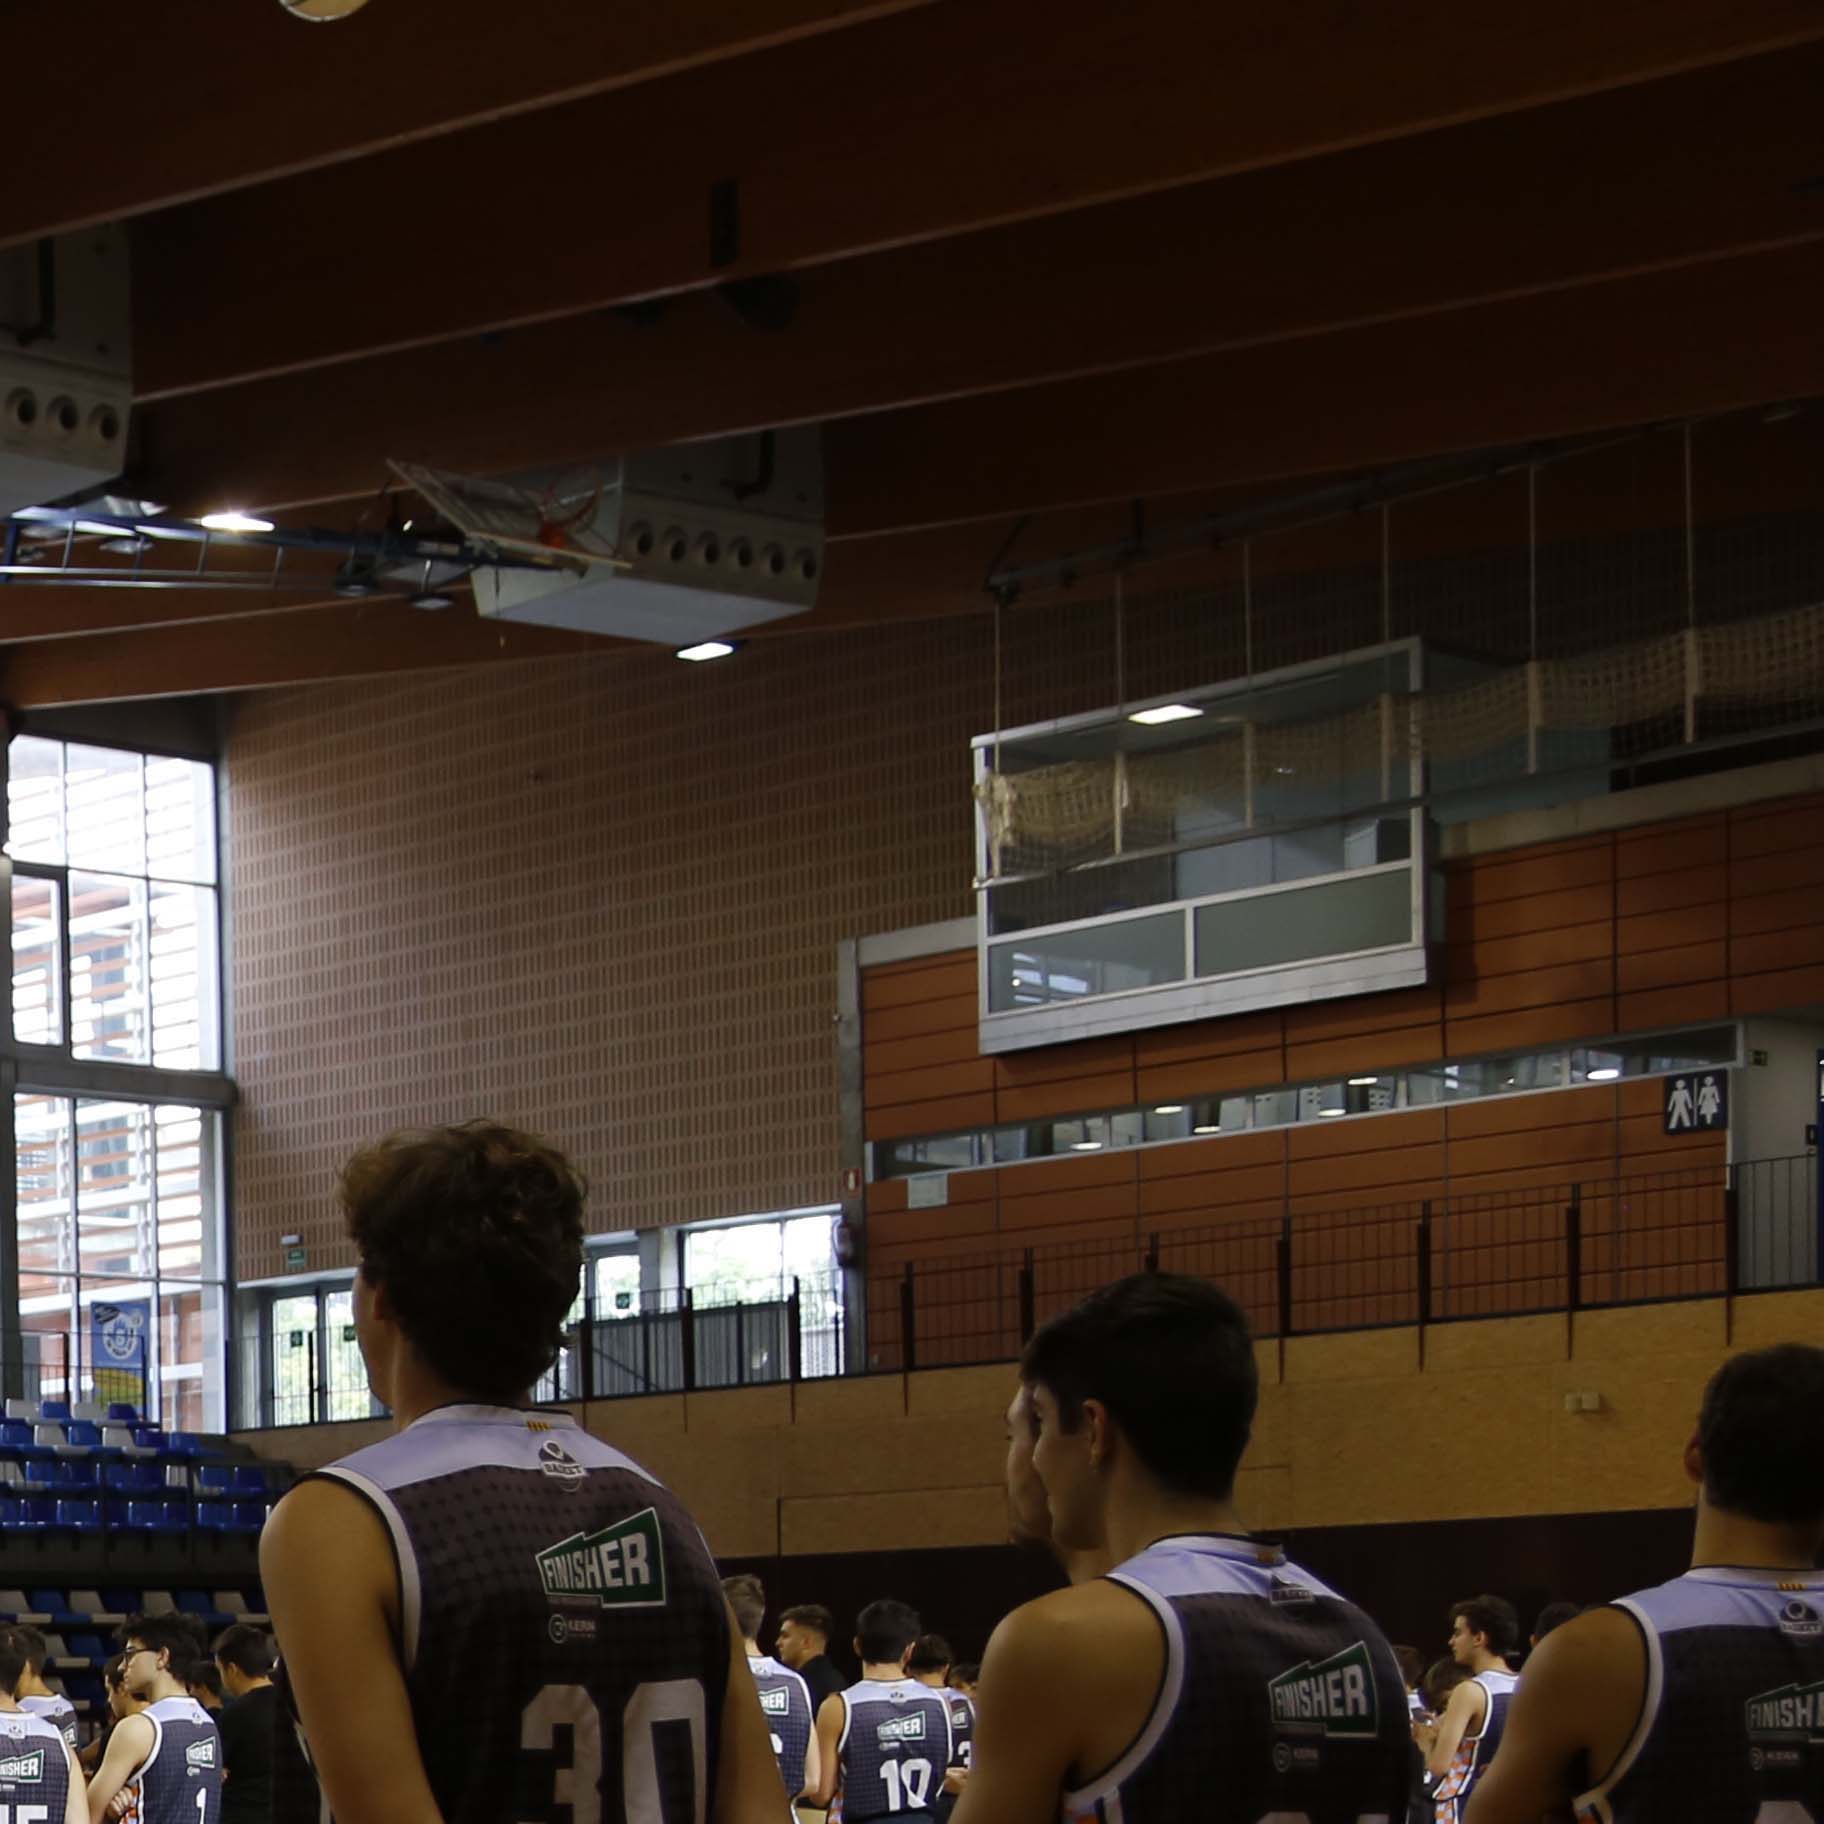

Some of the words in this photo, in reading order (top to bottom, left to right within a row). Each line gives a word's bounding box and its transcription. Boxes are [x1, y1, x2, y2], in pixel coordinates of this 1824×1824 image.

[543, 1532, 650, 1589] FINISHER
[1275, 1664, 1366, 1717] FINISHER
[880, 1758, 932, 1812] 10
